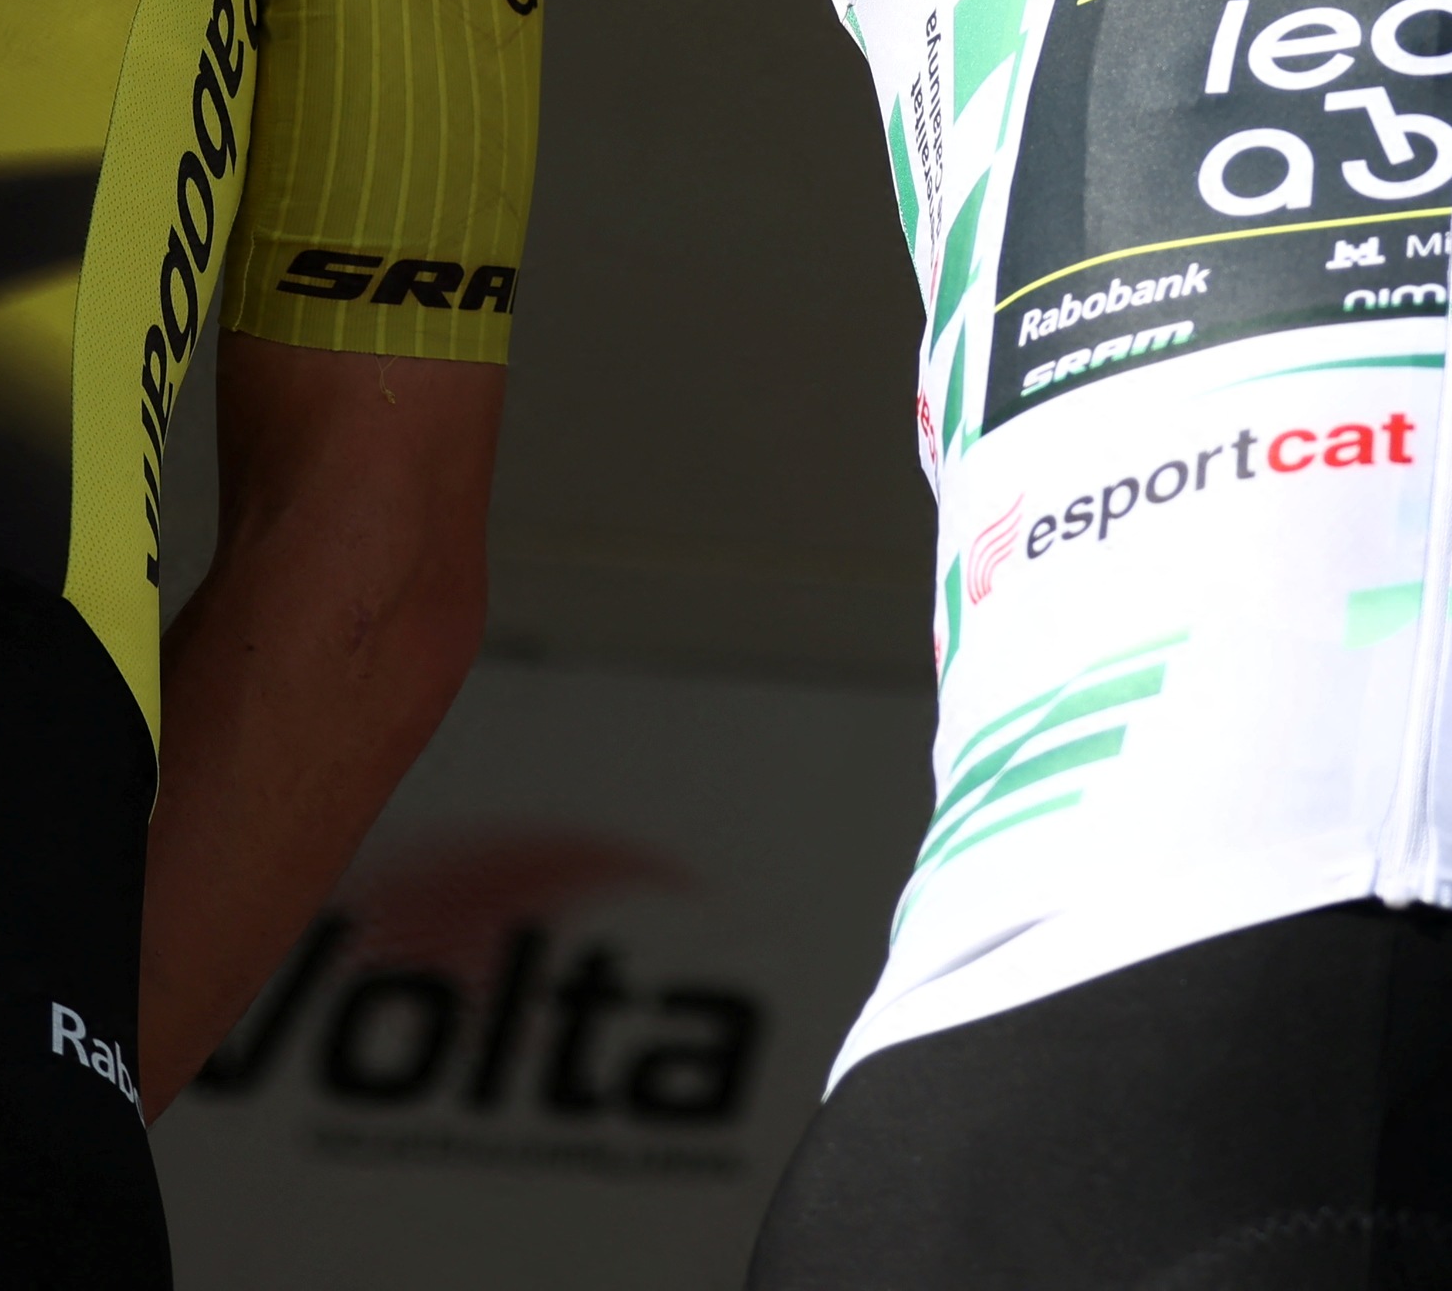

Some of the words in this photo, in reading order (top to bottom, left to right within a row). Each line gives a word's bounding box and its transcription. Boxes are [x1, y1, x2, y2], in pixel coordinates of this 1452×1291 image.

[277, 249, 516, 315] SRA
[1018, 263, 1212, 347] Rabobank
[1020, 320, 1197, 397] SRAM
